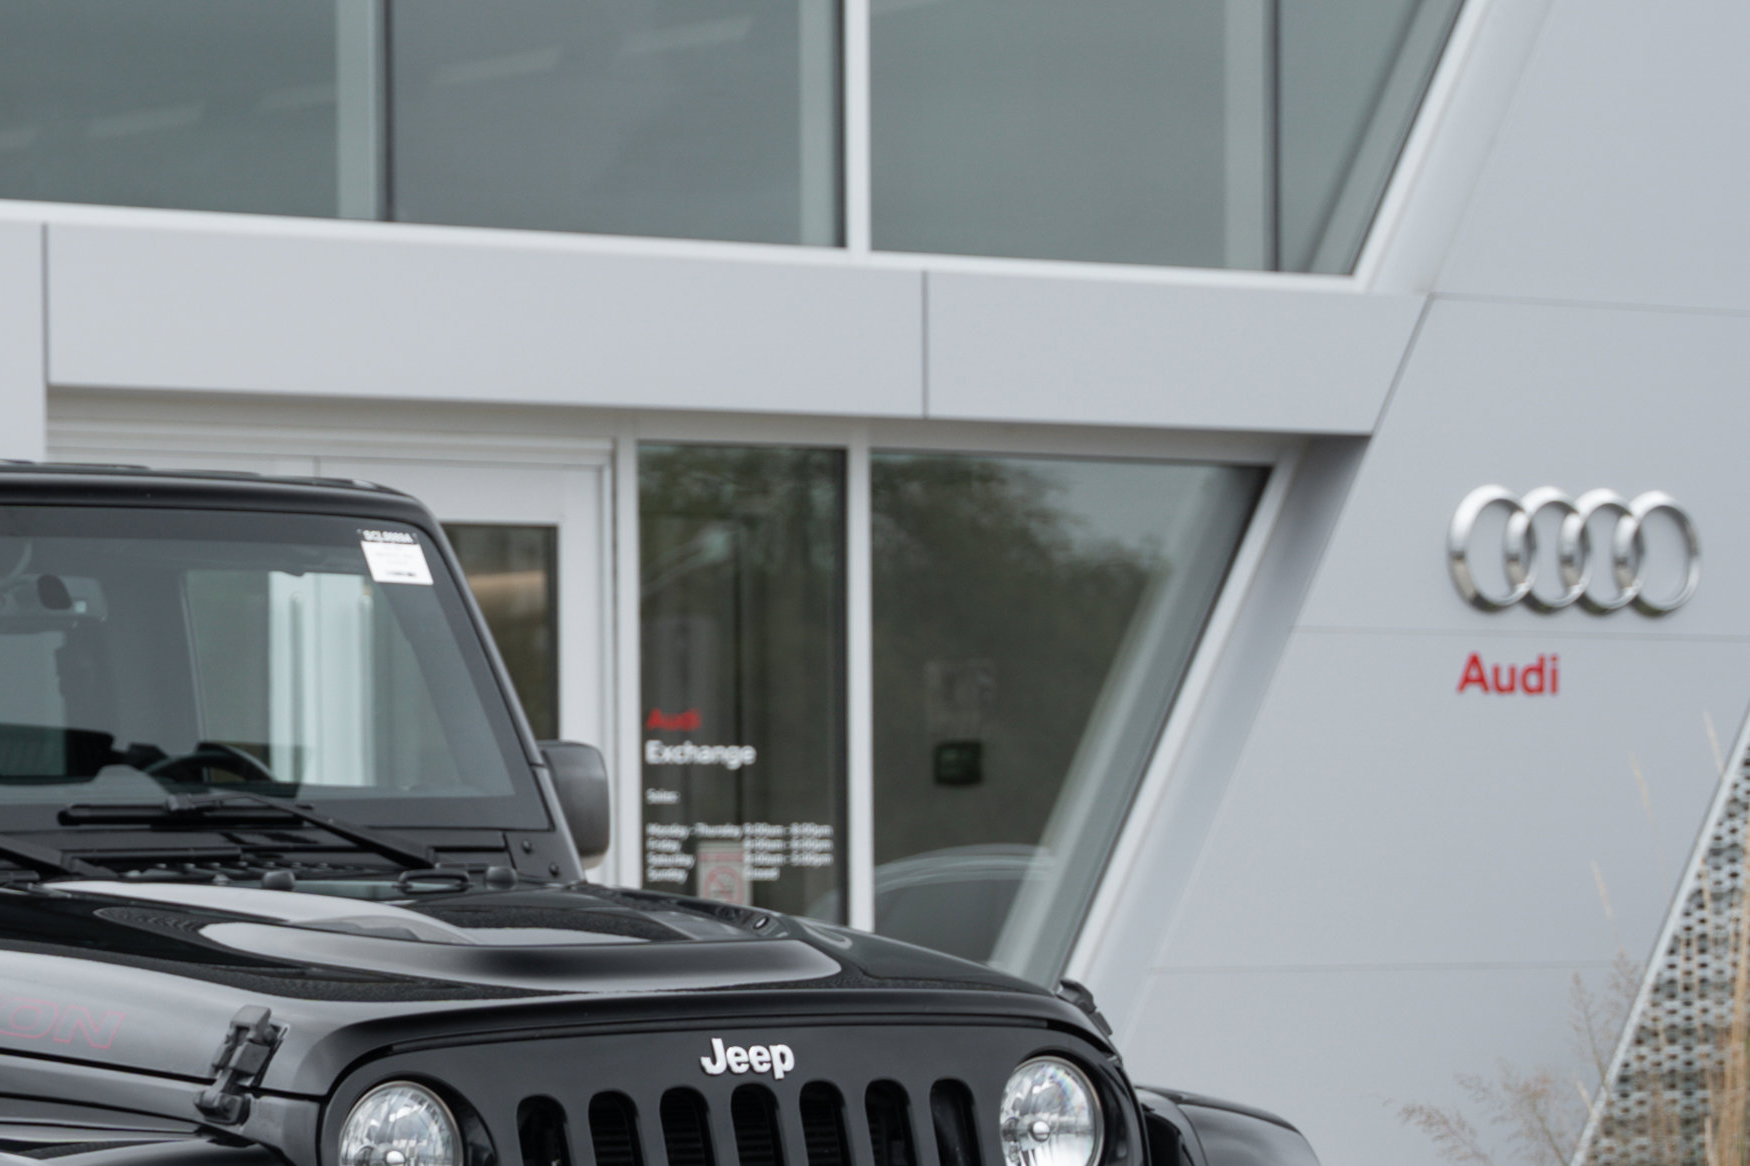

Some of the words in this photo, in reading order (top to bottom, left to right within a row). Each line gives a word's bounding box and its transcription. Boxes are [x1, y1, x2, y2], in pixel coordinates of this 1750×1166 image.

[1457, 651, 1560, 695] Audi
[646, 707, 702, 731] Audi
[645, 740, 757, 770] Exchange
[700, 1038, 795, 1080] Jeep
